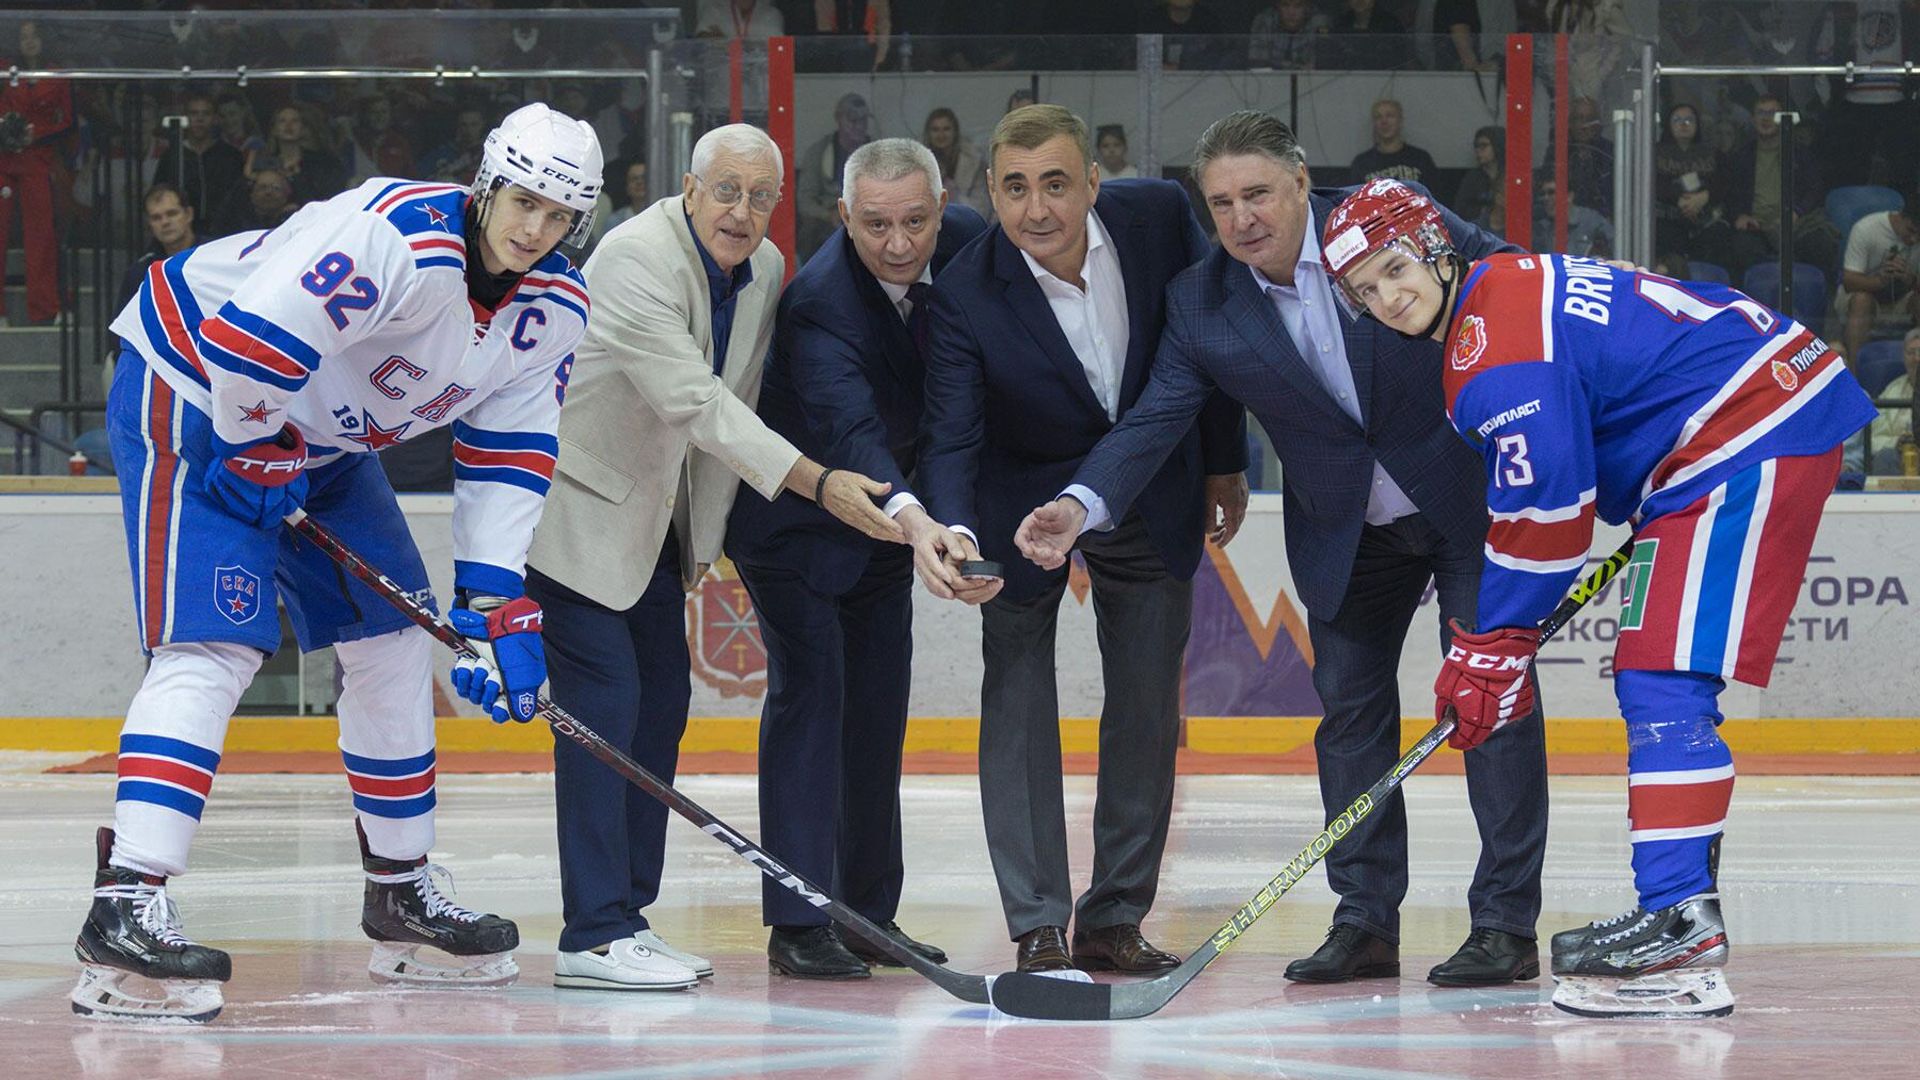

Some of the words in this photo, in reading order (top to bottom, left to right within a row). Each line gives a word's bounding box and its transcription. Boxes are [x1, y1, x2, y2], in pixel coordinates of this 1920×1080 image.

[542, 167, 580, 187] CCM
[300, 251, 379, 332] 92
[232, 446, 308, 474] TRU
[1446, 644, 1530, 671] CCM
[701, 822, 832, 908] CCM
[1212, 793, 1374, 952] SHERWOOD
